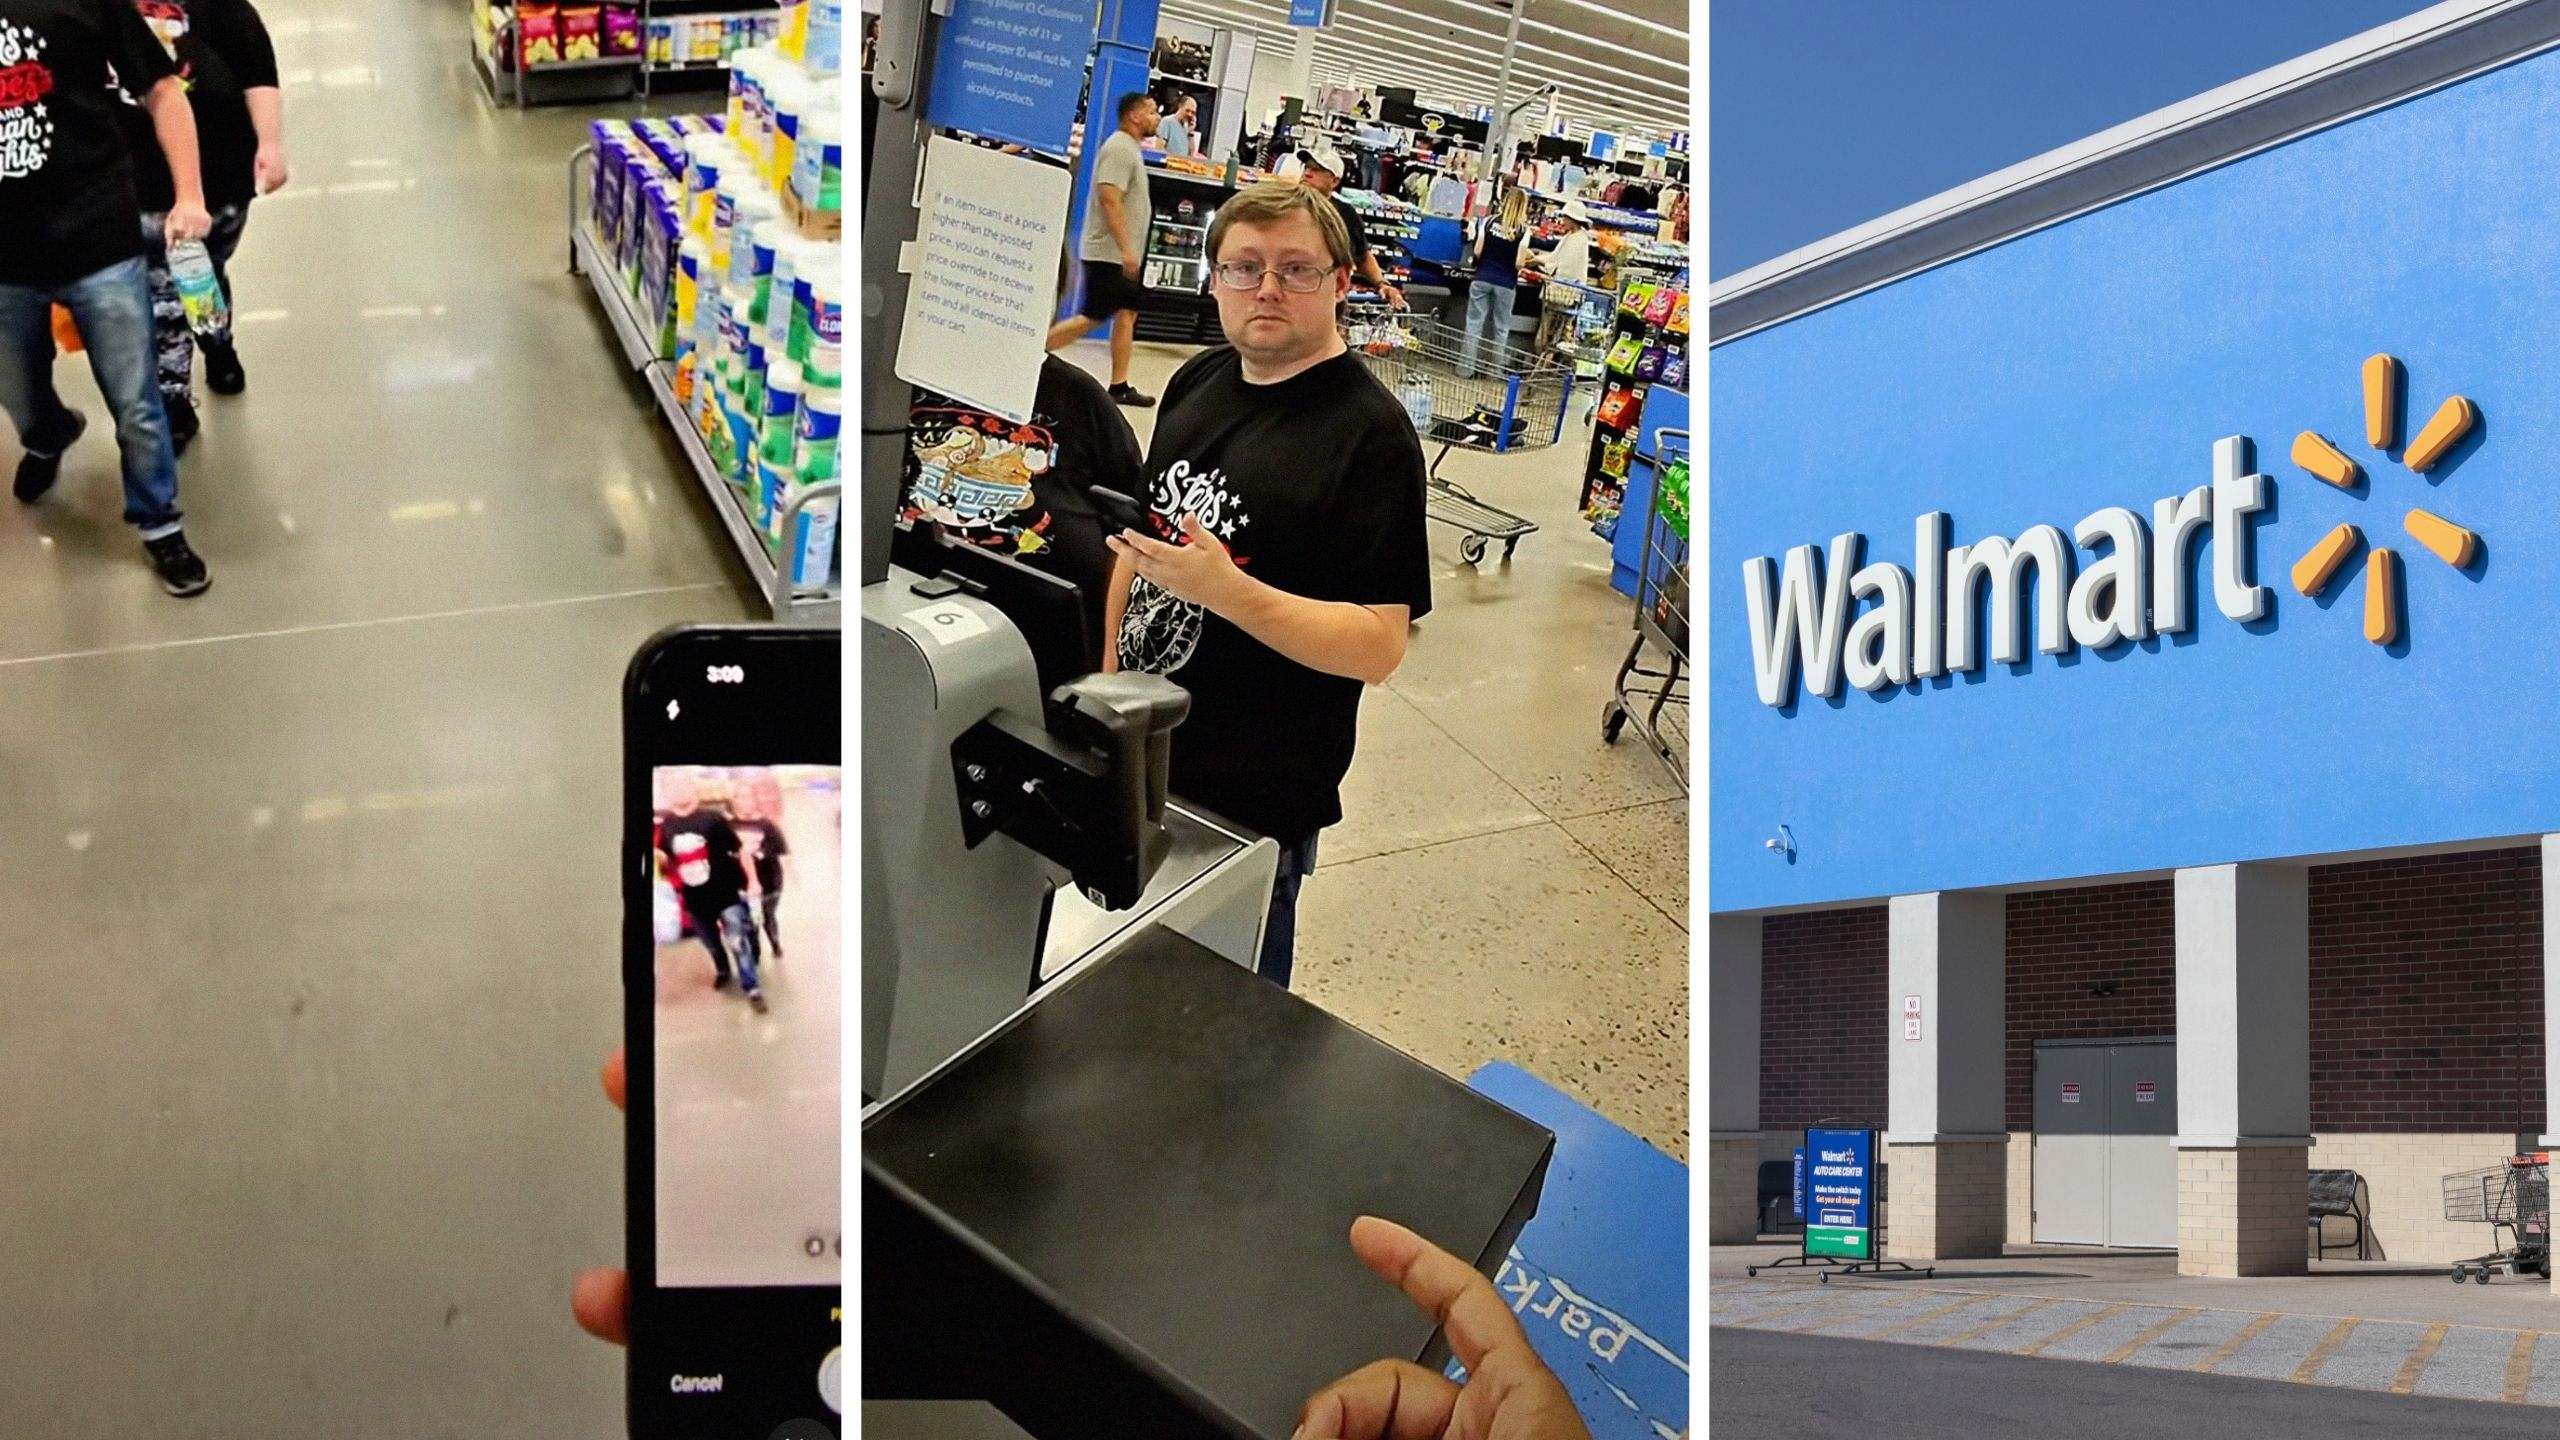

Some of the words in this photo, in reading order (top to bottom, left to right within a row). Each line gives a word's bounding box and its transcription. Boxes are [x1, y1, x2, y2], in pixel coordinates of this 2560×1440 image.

[997, 19, 1011, 32] the
[1029, 25, 1041, 38] of
[986, 42, 1016, 56] proper
[1016, 46, 1027, 57] ID
[1042, 54, 1058, 65] not
[1004, 68, 1014, 79] to
[1014, 71, 1054, 88] purchase
[966, 81, 995, 96] alcohol
[943, 195, 954, 206] an
[955, 199, 977, 212] item
[978, 207, 1002, 221] scans
[1004, 214, 1014, 224] at
[1014, 217, 1021, 226] a
[1022, 218, 1047, 234] price
[932, 212, 960, 227] higher
[961, 220, 981, 235] than
[983, 227, 999, 240] the
[1000, 233, 1033, 251] posted
[955, 241, 972, 254] you
[973, 246, 990, 258] can
[991, 251, 1026, 270] request
[927, 252, 949, 266] price
[950, 260, 987, 279] override
[988, 271, 999, 283] to
[1001, 276, 1034, 294] receive
[924, 270, 939, 282] the
[940, 275, 964, 291] lower
[966, 285, 988, 300] price
[990, 292, 1004, 304] for
[1006, 297, 1025, 313] that
[926, 313, 945, 326] your
[942, 298, 958, 311] and
[971, 307, 1009, 329] identical
[1010, 320, 1036, 338] items
[1151, 460, 1227, 529] Stars
[1743, 435, 2265, 708] Walmart
[1821, 1150, 1846, 1162] Walmart
[1813, 1166, 1828, 1176] AUTO
[1828, 1166, 1842, 1176] CARE
[1842, 1166, 1863, 1177] CENTER
[1815, 1185, 1827, 1193] Make
[1835, 1186, 1849, 1194] switch
[1816, 1195, 1824, 1203] Get
[1824, 1197, 1835, 1205] your
[1824, 1215, 1839, 1224] ENTER
[1840, 1216, 1853, 1225] HERE
[671, 1374, 723, 1392] Cancel
